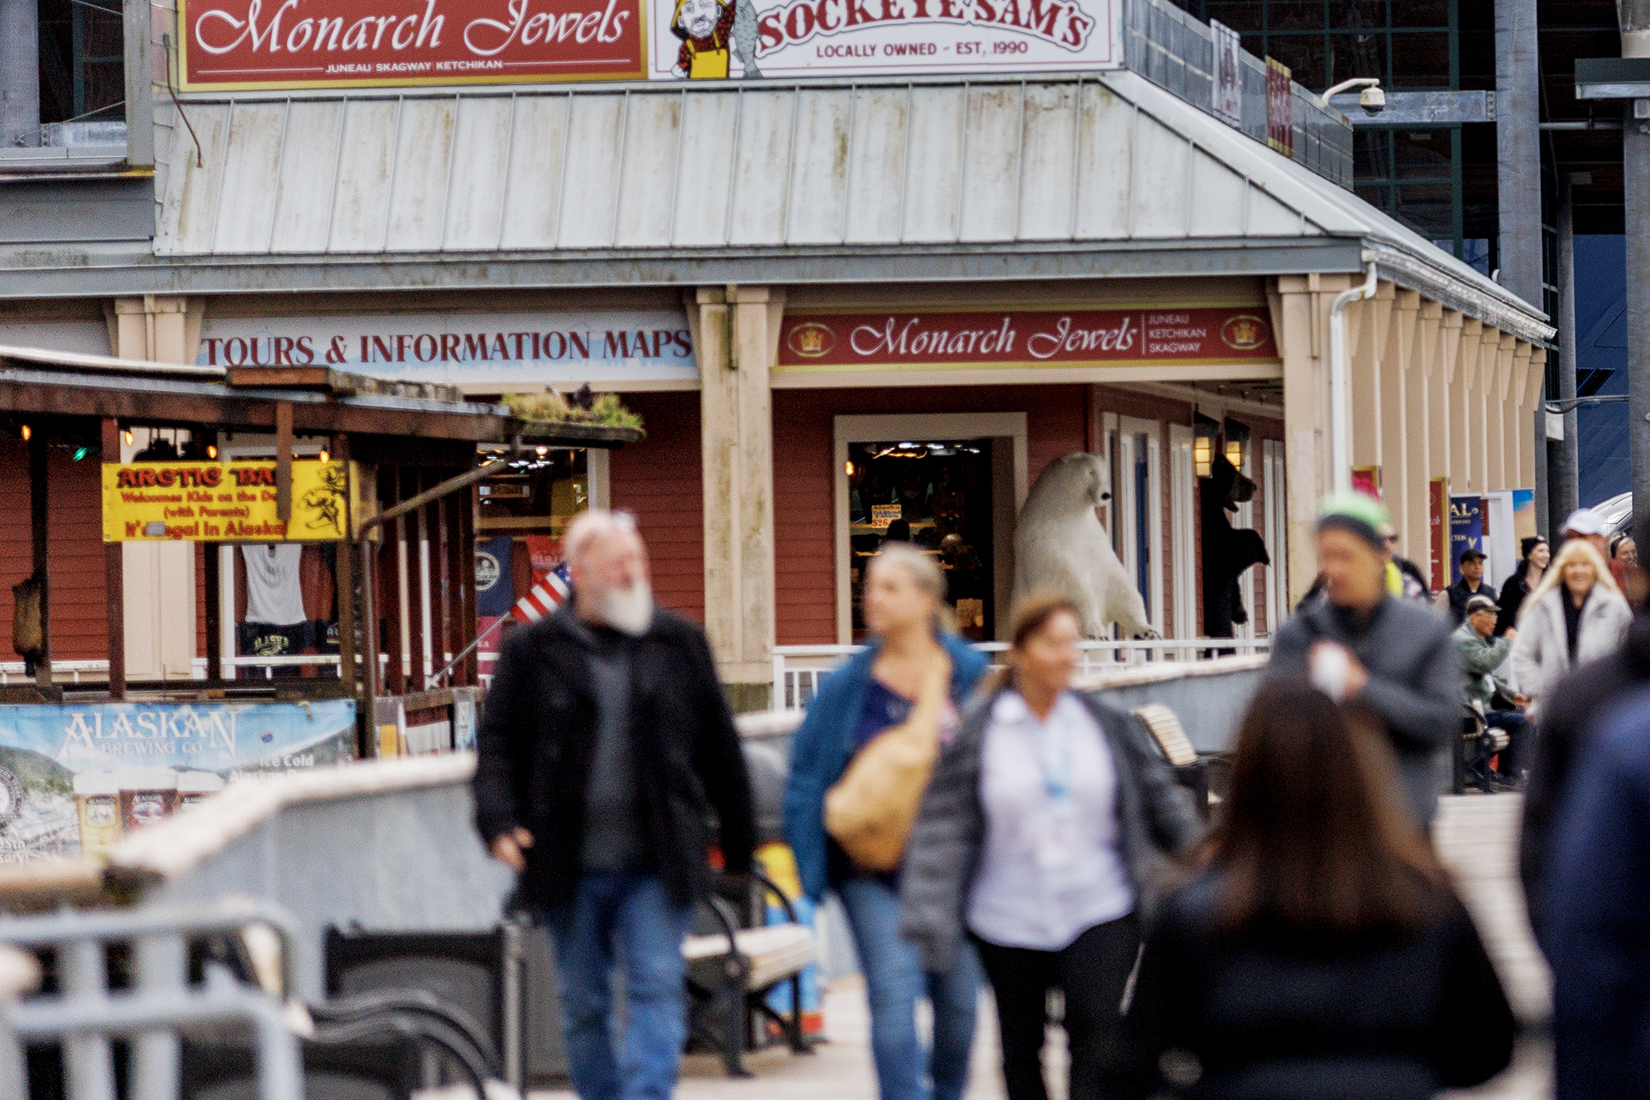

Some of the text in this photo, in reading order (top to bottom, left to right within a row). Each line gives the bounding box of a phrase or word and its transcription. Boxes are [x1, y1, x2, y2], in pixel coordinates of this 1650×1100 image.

[816, 44, 876, 57] LOCALLY
[883, 43, 937, 56] OWNED
[992, 41, 1028, 54] 1990
[325, 60, 502, 73] JUNEAU SKAGWAY KETCHIKAN
[1149, 314, 1189, 324] JUNEAU
[850, 316, 1138, 358] Monarch Jewels
[1149, 328, 1206, 338] KETCHIKAN
[200, 330, 692, 365] TOURS & INFORMATION MAPS
[1149, 343, 1201, 353] SKAGWAY
[117, 467, 277, 488] ARCTIC BA
[121, 491, 182, 502] Welcomes
[187, 490, 213, 502] Kids
[217, 492, 233, 502] on
[237, 491, 257, 502] the
[163, 521, 199, 540] egal
[204, 521, 219, 536] In
[56, 710, 240, 761] ALASKAN
[101, 742, 175, 755] BREWING
[260, 754, 314, 767] Ice Cold
